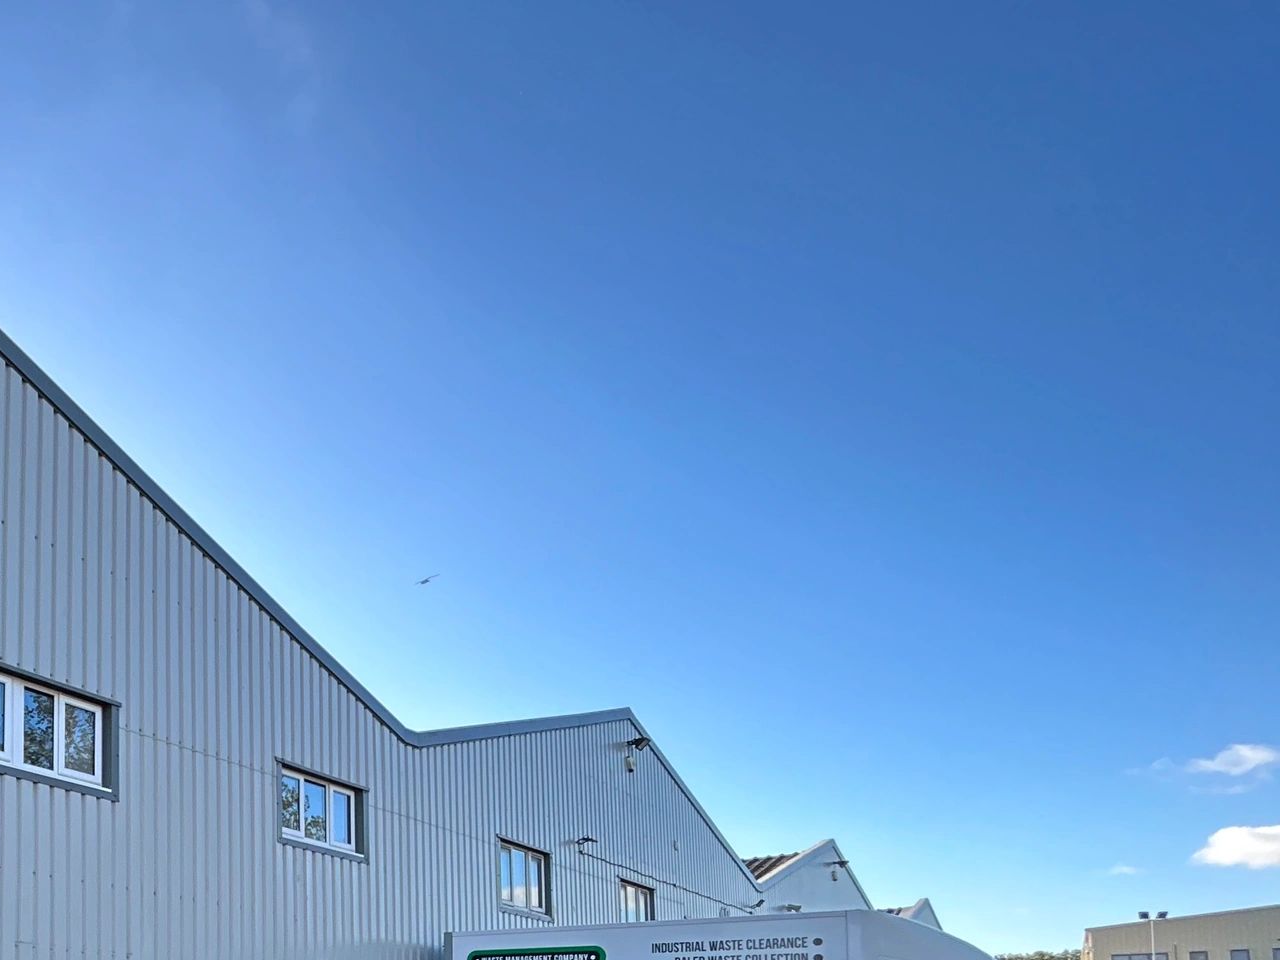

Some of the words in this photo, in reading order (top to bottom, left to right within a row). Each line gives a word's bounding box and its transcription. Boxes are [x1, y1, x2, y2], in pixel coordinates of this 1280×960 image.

[651, 941, 706, 953] INDUSTRIAL
[709, 939, 743, 951] WASTE
[746, 936, 808, 950] CLEARANCE
